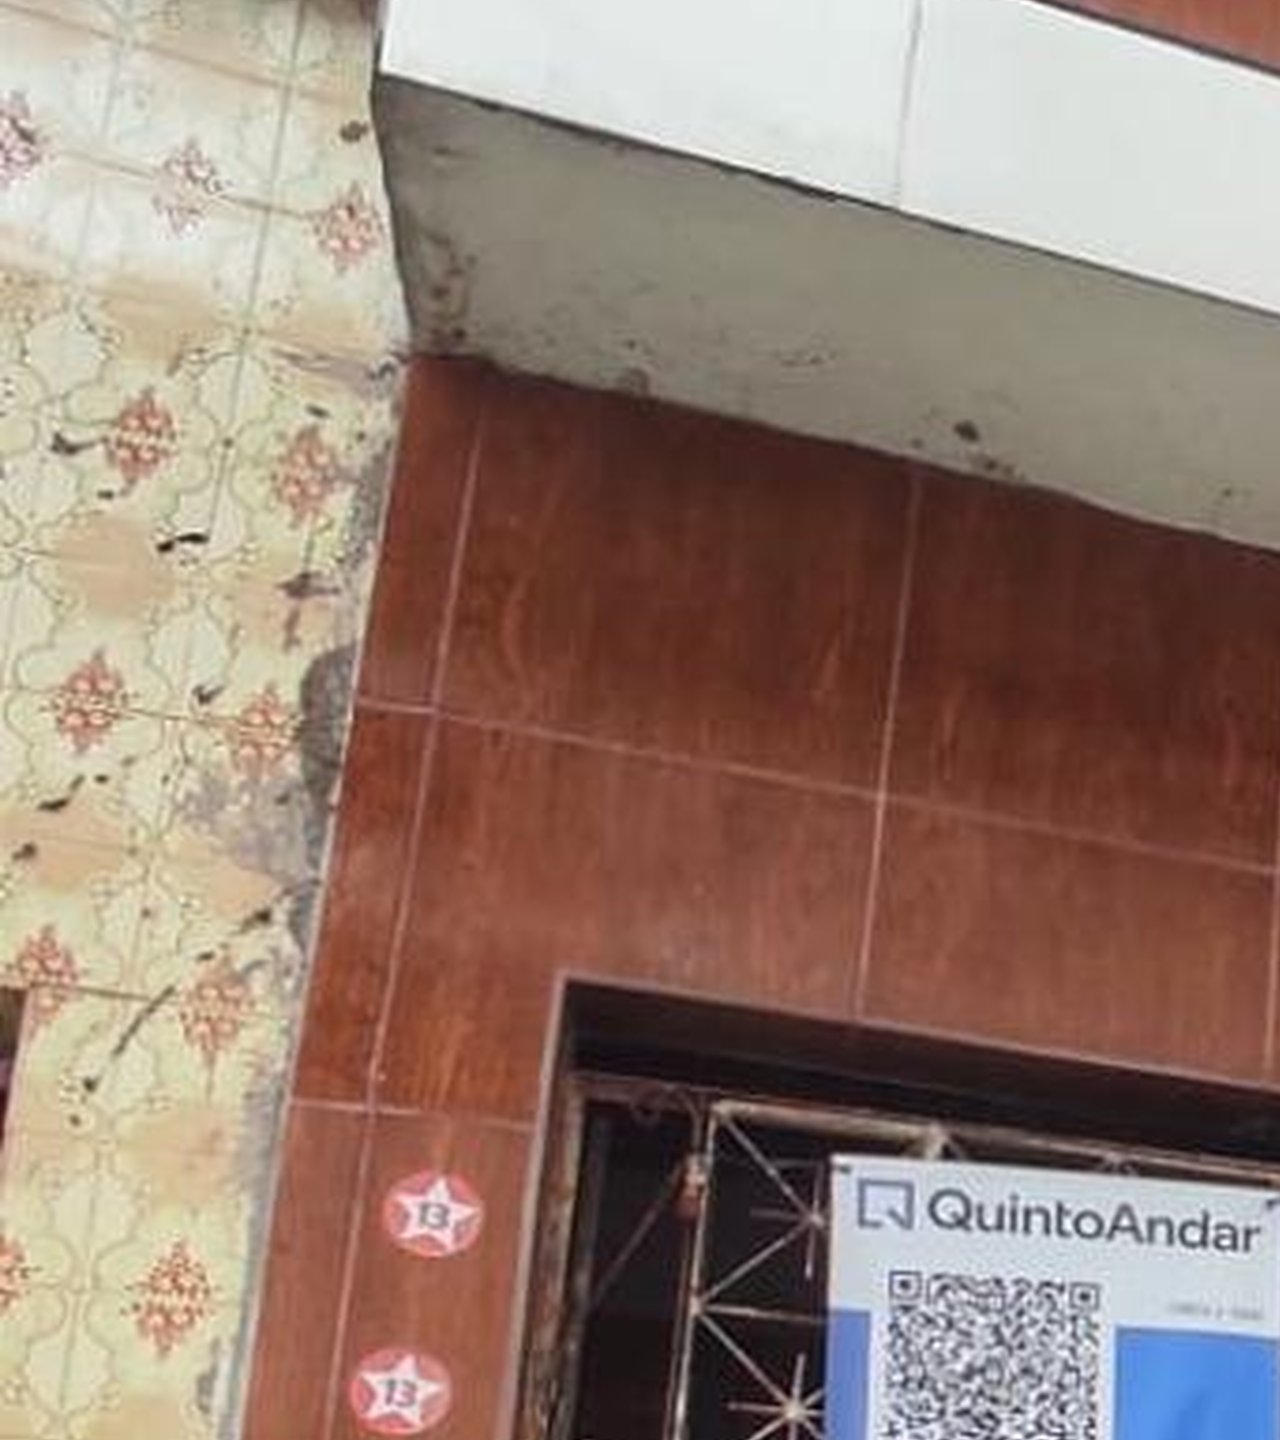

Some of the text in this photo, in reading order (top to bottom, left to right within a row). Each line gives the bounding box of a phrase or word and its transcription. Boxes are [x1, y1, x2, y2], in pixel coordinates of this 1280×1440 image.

[418, 1201, 450, 1230] 13
[927, 1188, 1262, 1254] QuintoAndar
[383, 1377, 416, 1409] 13
